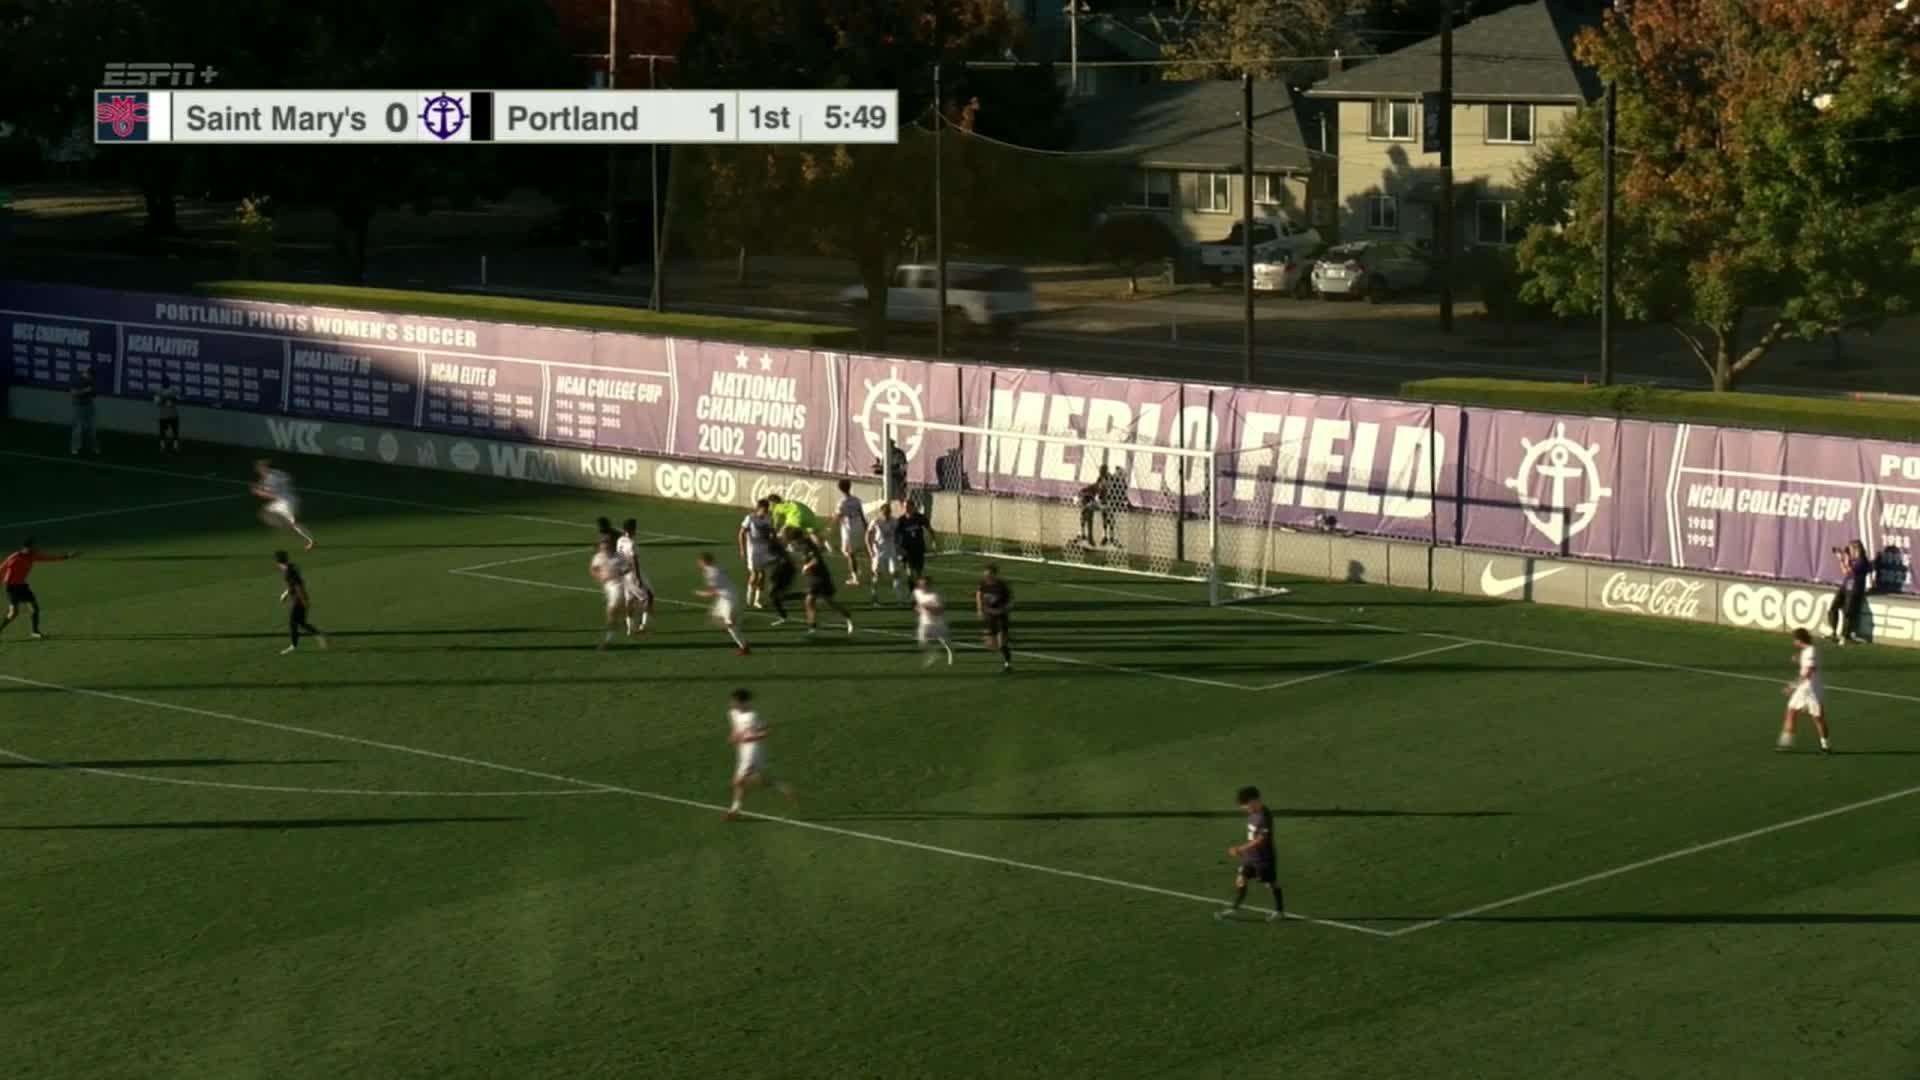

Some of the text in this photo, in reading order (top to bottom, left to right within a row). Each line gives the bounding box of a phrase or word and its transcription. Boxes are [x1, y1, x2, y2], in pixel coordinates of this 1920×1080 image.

[155, 303, 477, 348] PORTLAND PILOTS WOMEN'S SOCCER
[154, 336, 200, 358] PLAYOFFS
[322, 352, 357, 373] SWEET
[431, 363, 497, 388] NCAA ELITE 8
[556, 375, 663, 404] NCAA COLLEGE CUP
[710, 370, 798, 403] NATIONAL
[696, 395, 807, 430] CHAMPIONS
[698, 425, 803, 462] 2002 2005
[978, 388, 1446, 519] MERLO FIELD
[580, 454, 638, 481] KUNP
[1687, 484, 1851, 522] NCAA COLLEGE CUP
[1687, 533, 1715, 548] 1995
